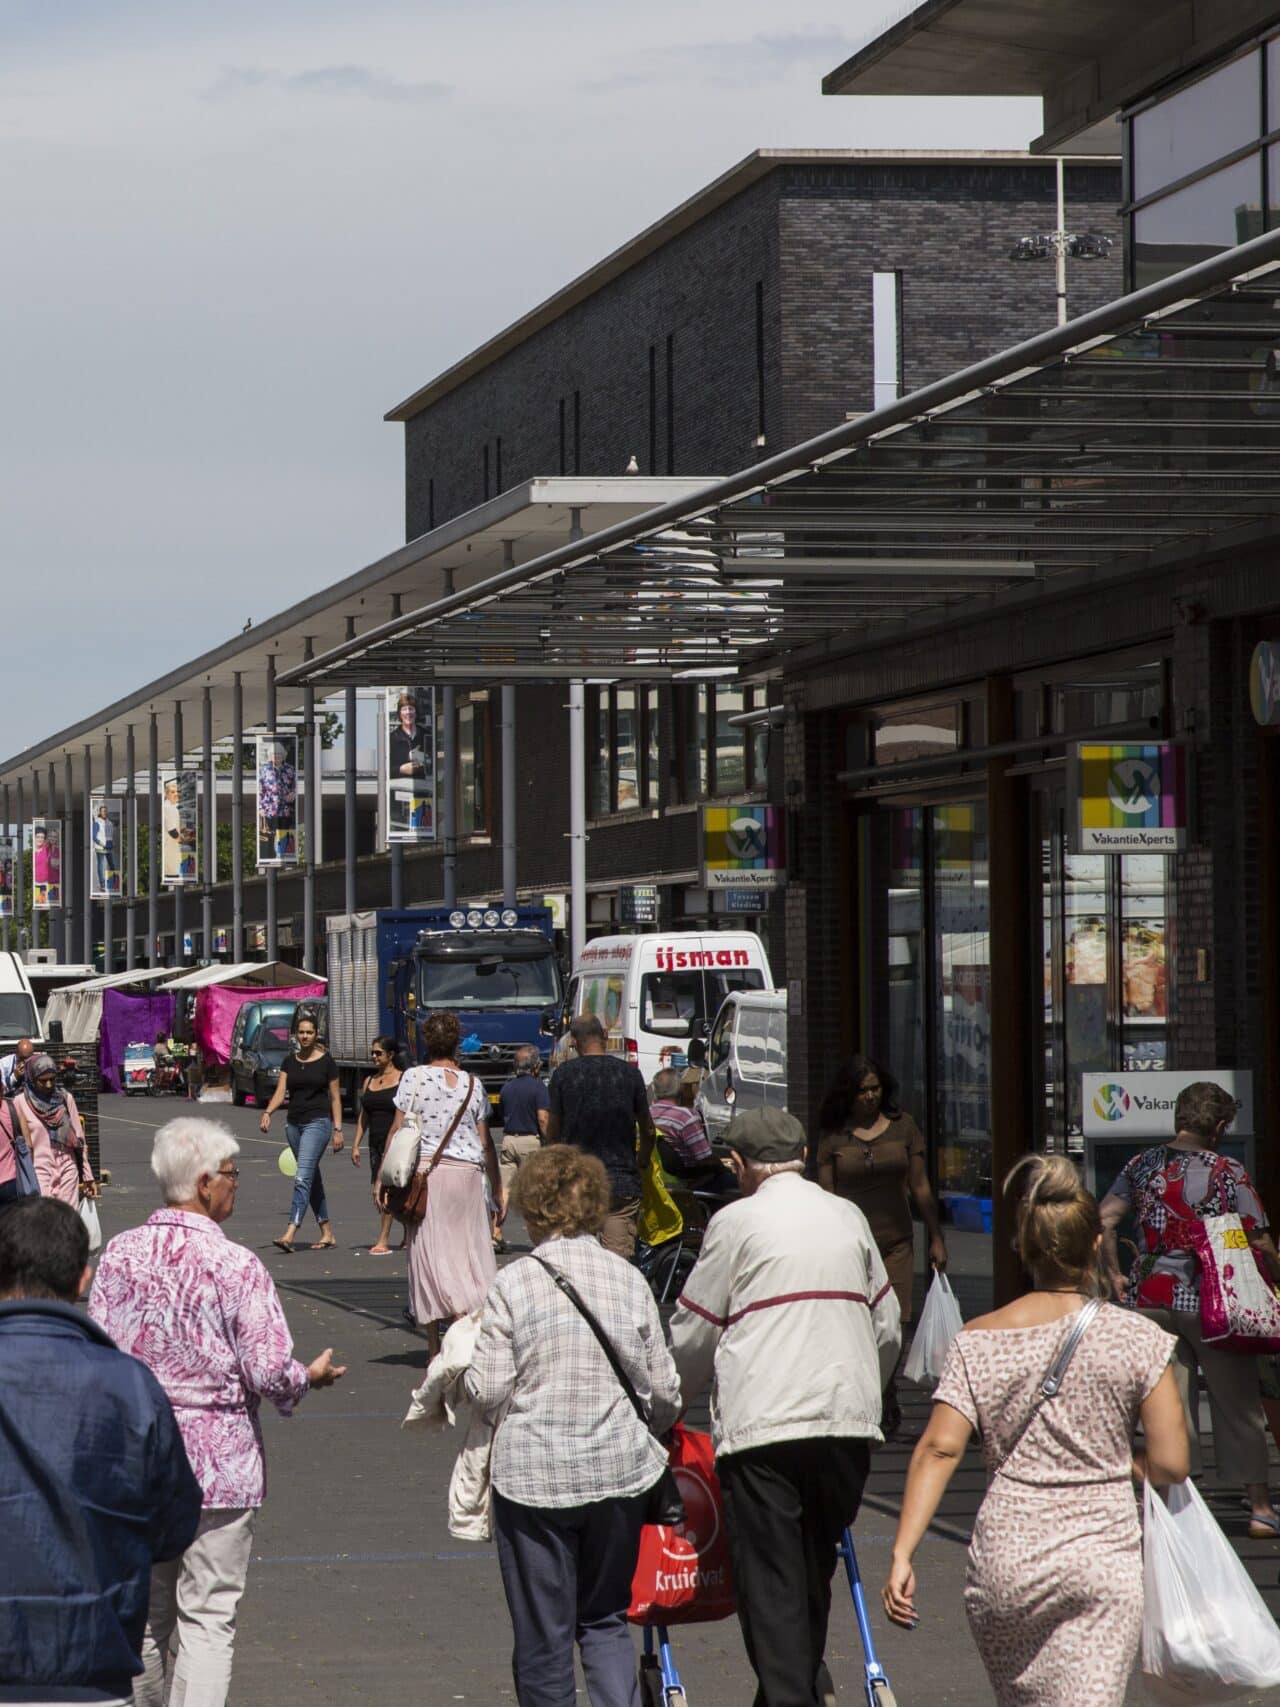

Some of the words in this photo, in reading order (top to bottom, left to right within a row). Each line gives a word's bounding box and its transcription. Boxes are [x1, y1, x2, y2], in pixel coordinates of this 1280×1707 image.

[1091, 832, 1175, 847] VakantieXperts
[656, 947, 749, 971] ijsman
[656, 1565, 725, 1592] Kruidvat
